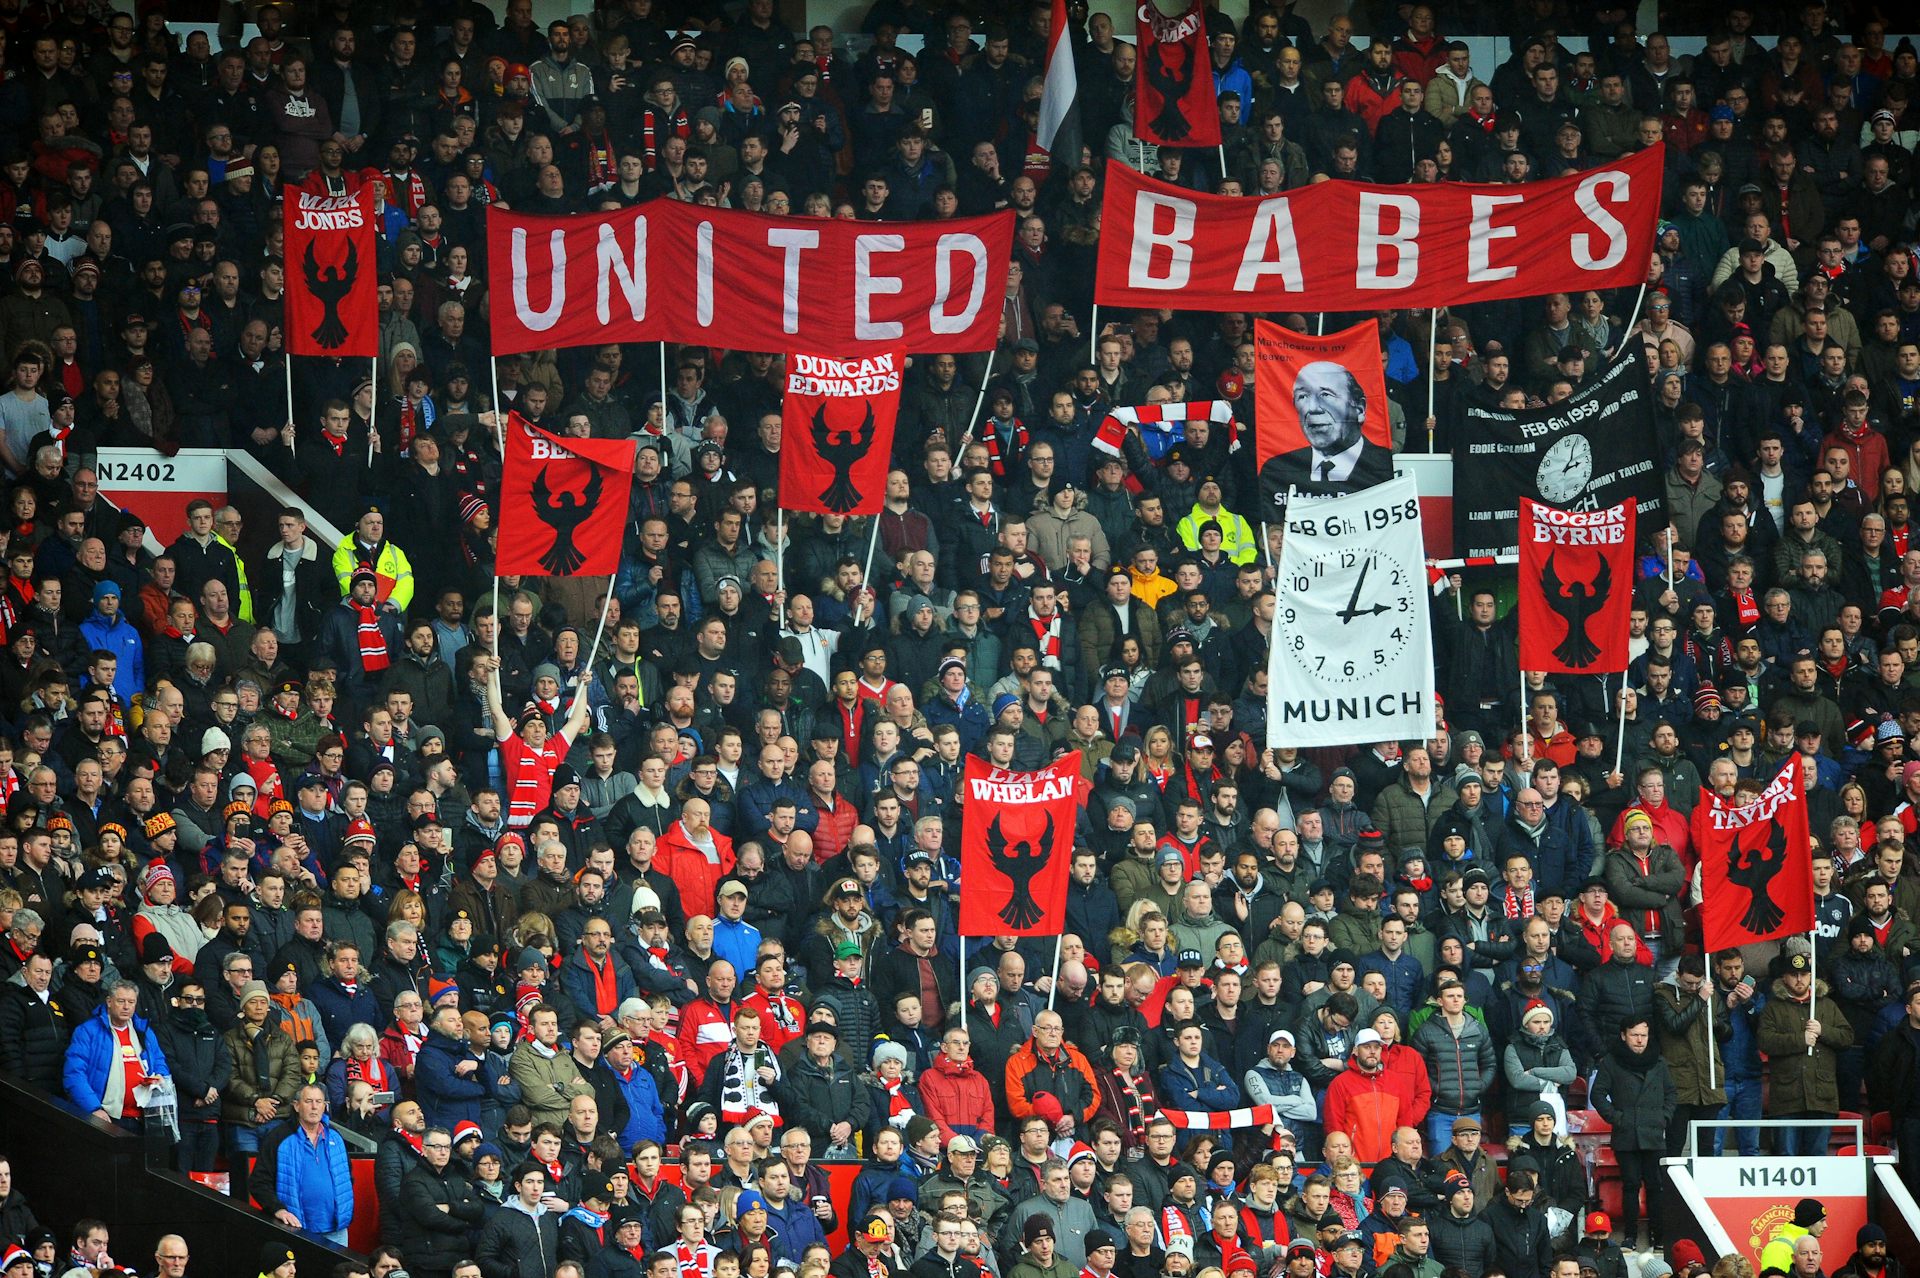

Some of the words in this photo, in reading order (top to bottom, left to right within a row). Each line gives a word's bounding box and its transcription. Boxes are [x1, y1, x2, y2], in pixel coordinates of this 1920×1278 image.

[299, 190, 361, 211] MARK
[295, 209, 364, 230] JONES
[1128, 170, 1631, 292] BABES
[511, 214, 988, 341] UNITED
[795, 353, 894, 378] DUNCAN
[788, 371, 899, 397] EDWARDS
[1520, 422, 1549, 438] FEB
[1567, 399, 1600, 423] 1958
[1469, 444, 1496, 454] EDDIE
[98, 462, 175, 482] N2402
[1618, 460, 1654, 478] TAYLOR
[1531, 503, 1626, 526] ROGER
[1636, 499, 1661, 514] BENT
[1324, 516, 1357, 537] 6th
[1364, 499, 1419, 532] 1958
[1469, 511, 1492, 521] LIAM
[1533, 523, 1625, 545] BYRNE
[1341, 553, 1355, 569] 12
[1469, 548, 1498, 558] MARK
[1314, 561, 1324, 577] 11
[1293, 576, 1309, 592] 10
[1390, 570, 1400, 585] 2
[1397, 597, 1408, 613] 3
[1285, 608, 1296, 624] 9
[1294, 635, 1304, 650] 8
[1390, 627, 1403, 642] 4
[1314, 656, 1325, 671] 7
[1373, 650, 1385, 664] 5
[1343, 661, 1354, 676] 6
[1284, 691, 1422, 724] MUNICH
[987, 767, 1059, 784] LIAM
[970, 775, 1074, 804] WHELAN
[1179, 951, 1200, 962] ICON
[1739, 1167, 1817, 1187] N1401
